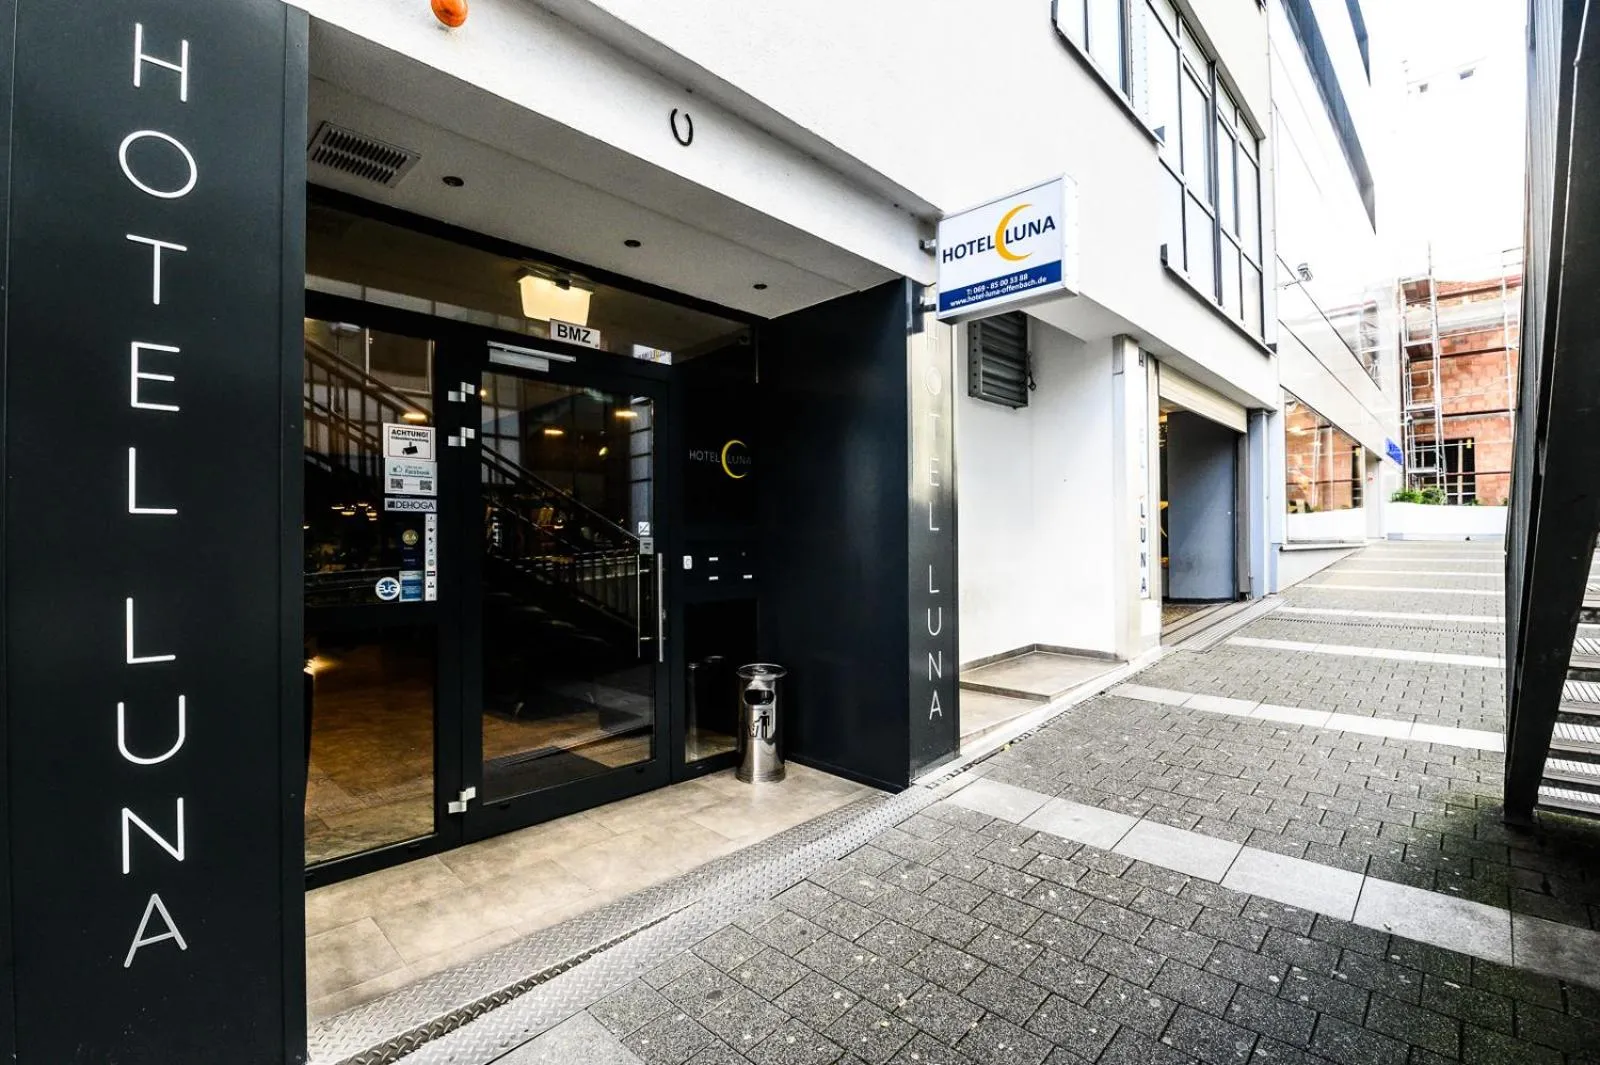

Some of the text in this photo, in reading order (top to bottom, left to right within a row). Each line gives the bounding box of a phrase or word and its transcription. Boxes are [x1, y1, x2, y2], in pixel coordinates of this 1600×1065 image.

[942, 215, 1056, 264] HOTEL LUNA
[949, 275, 1048, 307] www.hotel-luna-offenbach.de
[973, 283, 986, 294] 069
[990, 280, 999, 290] 85
[999, 278, 1009, 287] 00
[1009, 275, 1018, 285] 33
[1019, 272, 1029, 282] 88
[557, 323, 592, 344] BMZ
[391, 429, 429, 438] ACHTUNG!
[689, 449, 721, 463] HOTEL
[117, 22, 198, 969] HOTEL LUNA
[396, 501, 434, 510] DEHOGA
[927, 564, 942, 721] LUNA
